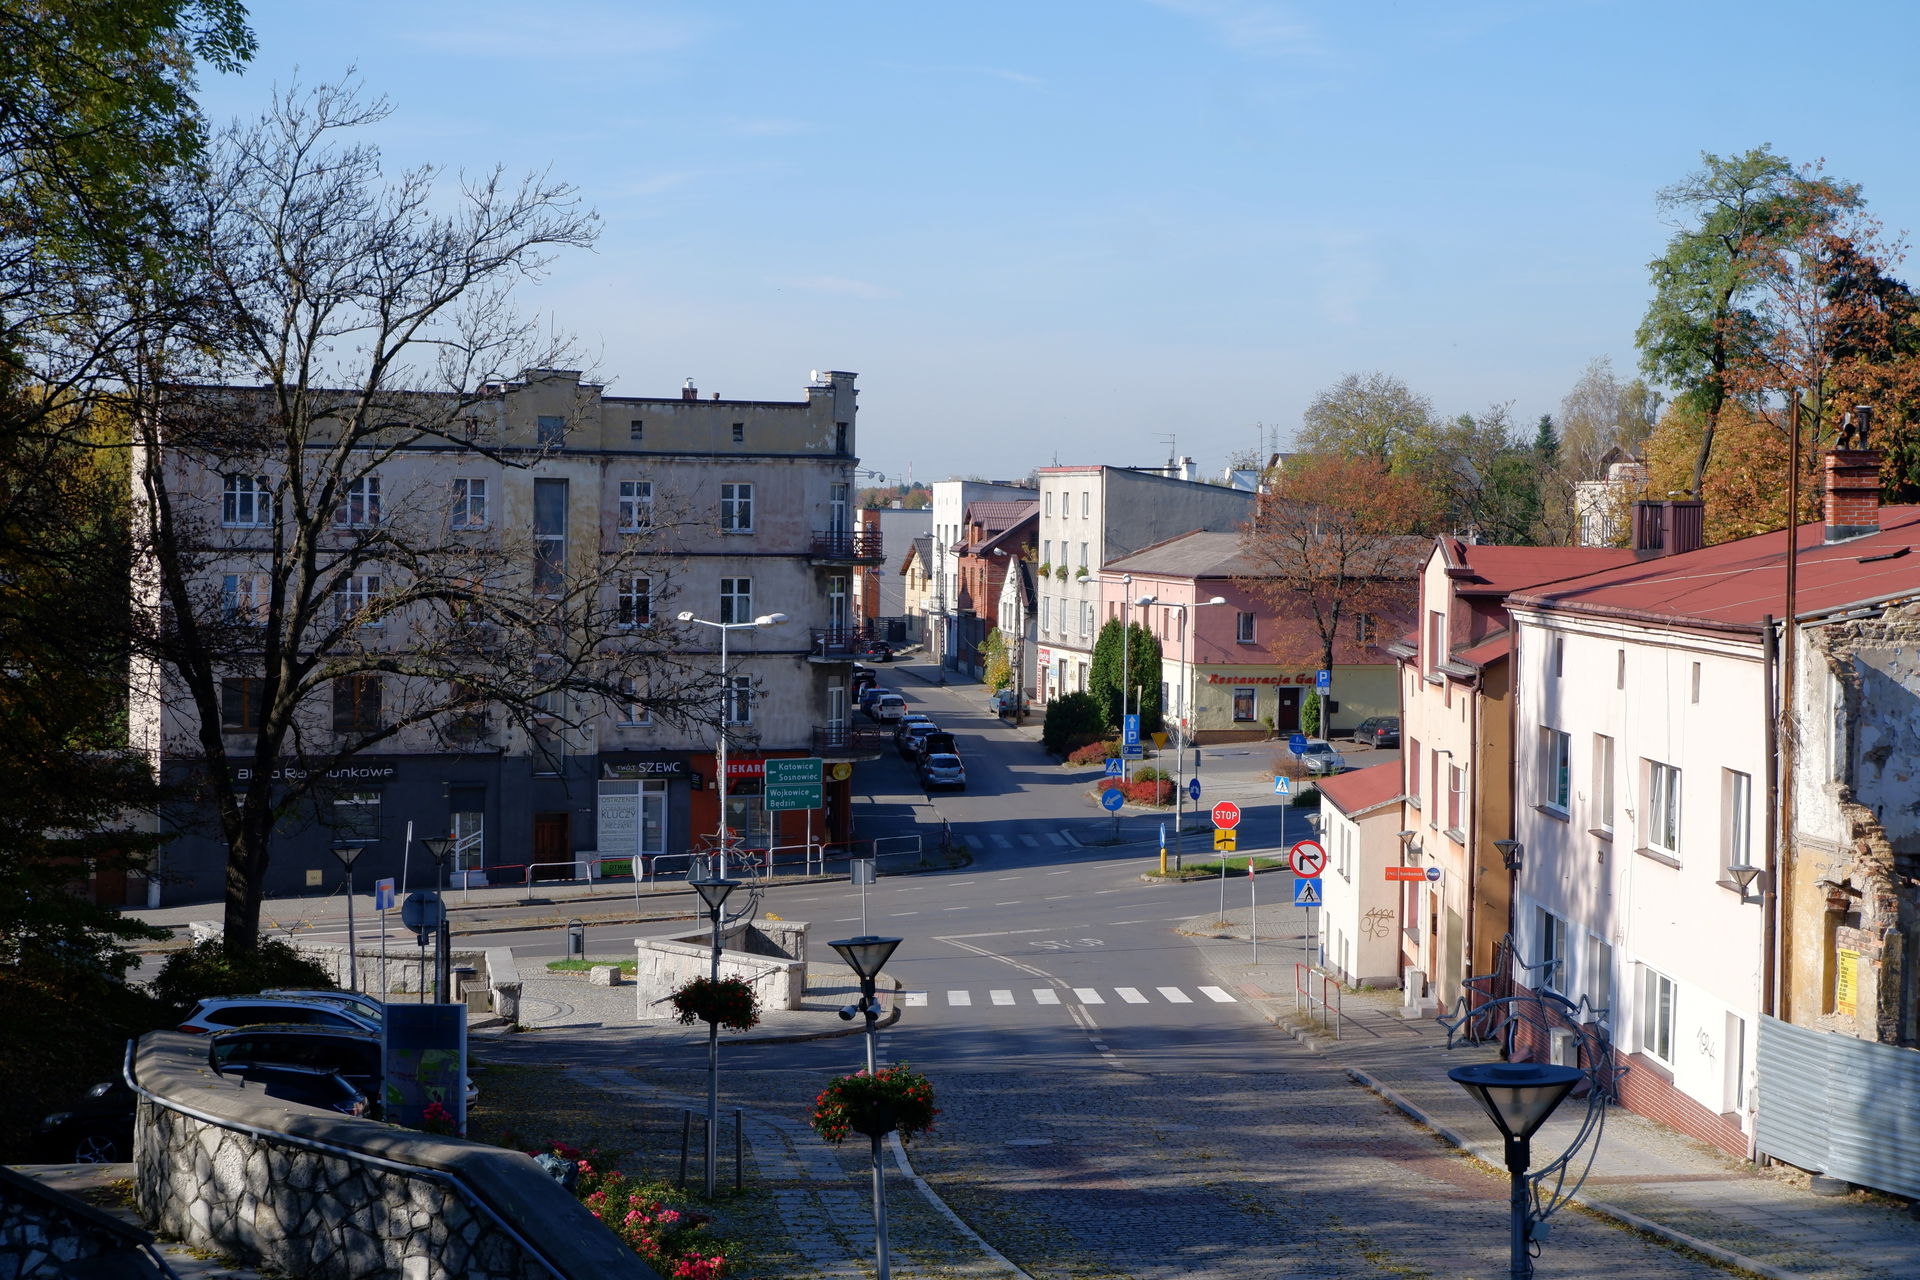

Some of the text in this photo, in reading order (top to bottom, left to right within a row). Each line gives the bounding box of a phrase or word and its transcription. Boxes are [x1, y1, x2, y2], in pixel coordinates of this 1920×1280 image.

[1209, 673, 1317, 686] Restauracja Ga
[1320, 671, 1328, 682] P
[1128, 731, 1137, 743] P
[638, 761, 681, 773] SZEWC
[727, 763, 765, 774] IEKAR
[778, 762, 814, 771] Katowice
[284, 766, 394, 780] Raunkowe
[778, 773, 818, 782] Sosnowiec
[769, 788, 810, 797] Wojkowice
[770, 800, 796, 808] Będzin
[601, 811, 636, 819] KLUCZY
[1215, 810, 1238, 820] STOP
